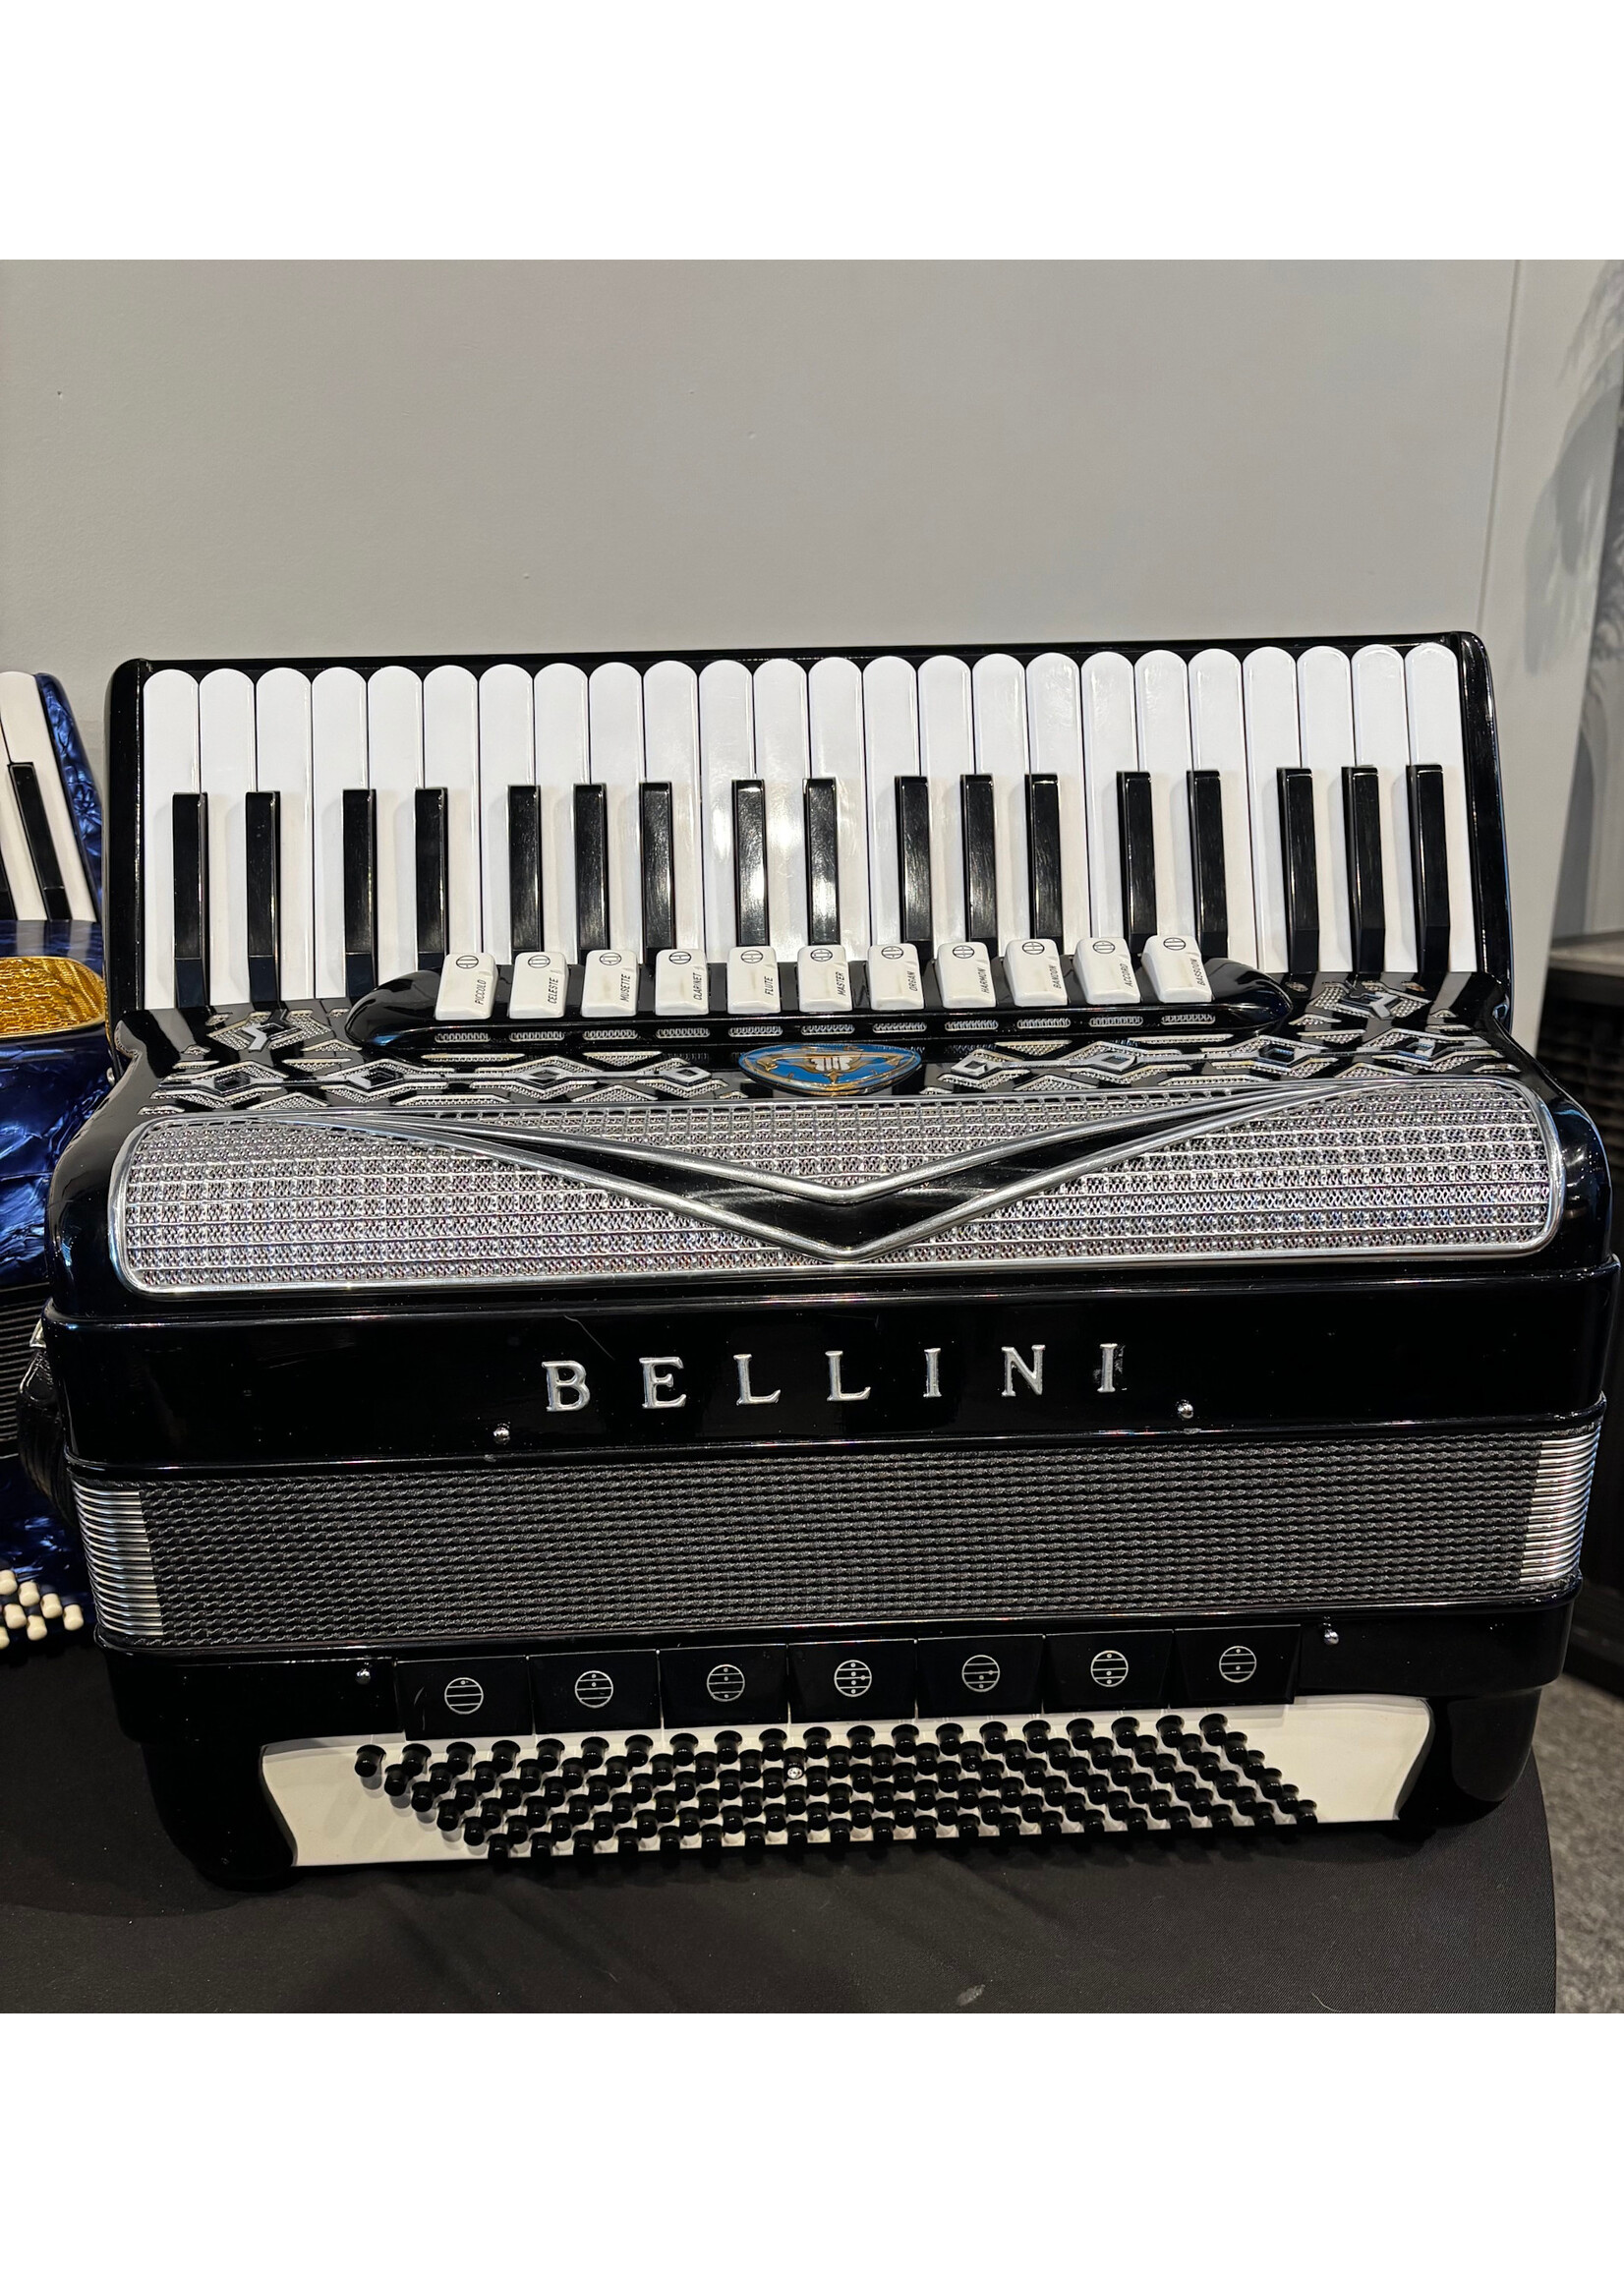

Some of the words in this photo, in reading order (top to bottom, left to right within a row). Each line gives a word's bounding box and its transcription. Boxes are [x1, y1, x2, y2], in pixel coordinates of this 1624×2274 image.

[692, 971, 703, 1001] CLARINET
[764, 975, 775, 996] FLUTE
[835, 971, 846, 996] MASTER
[906, 970, 918, 992] ORGAN
[977, 966, 991, 994] HARMON
[1047, 963, 1063, 990] BANDON
[1119, 962, 1133, 988] ACCORD
[1189, 958, 1207, 987] BASSOON
[474, 979, 487, 1006] PICCOLO
[547, 977, 559, 1005] CELESTE
[619, 973, 631, 1003] MUSETTE
[541, 1342, 1120, 1412] BELLINI
